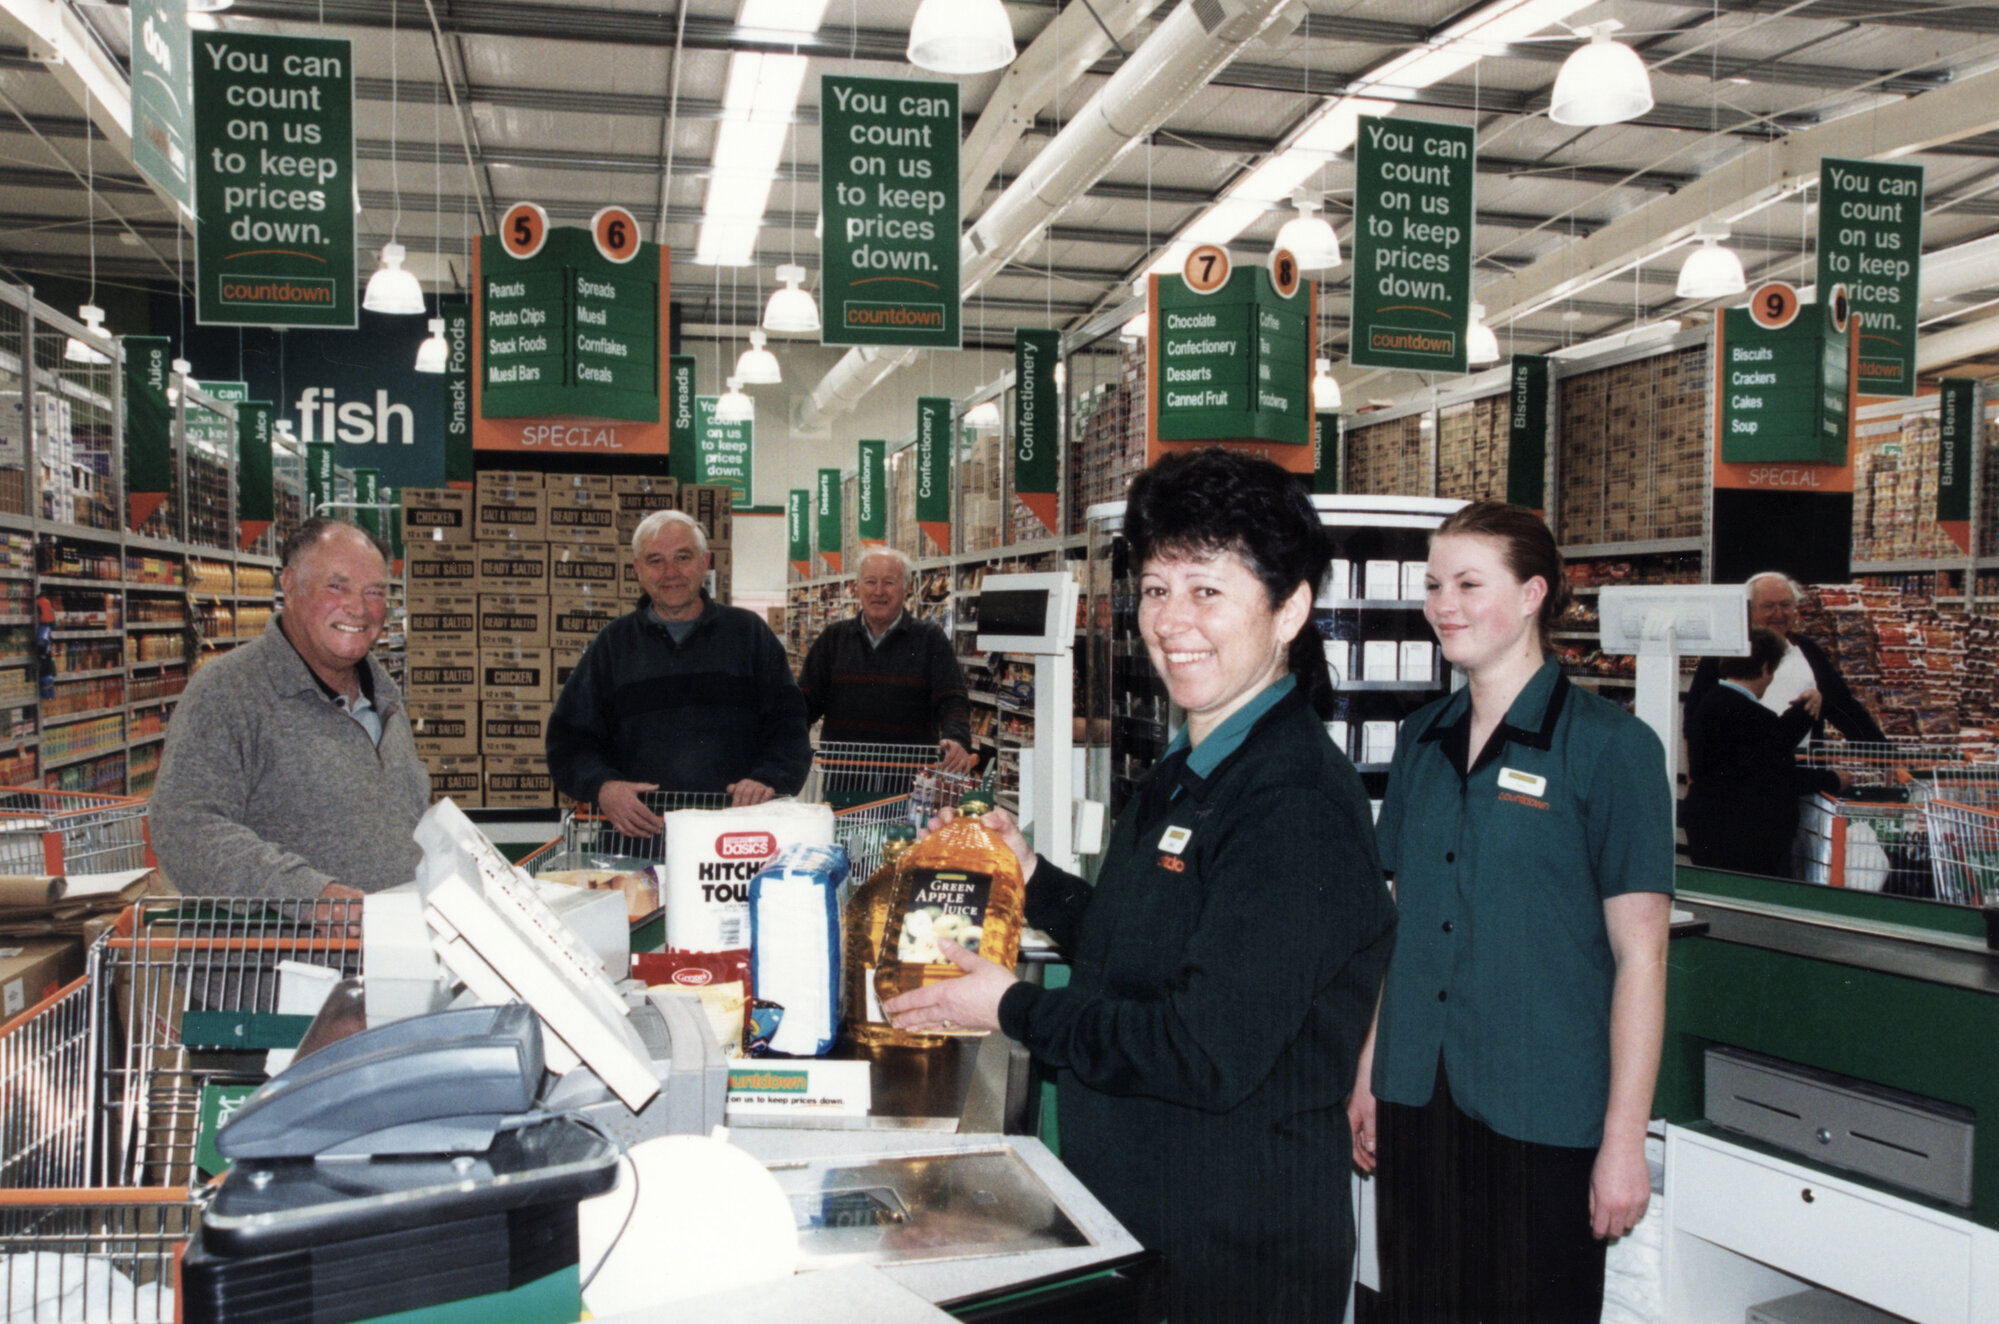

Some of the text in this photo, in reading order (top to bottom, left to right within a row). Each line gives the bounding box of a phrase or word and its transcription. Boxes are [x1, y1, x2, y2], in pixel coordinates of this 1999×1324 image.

[205, 42, 342, 78] You can
[226, 85, 321, 111] count
[833, 86, 950, 117] You can
[227, 119, 321, 144] on us
[850, 124, 932, 147] count
[1368, 125, 1466, 159] You can
[212, 148, 338, 184] to keep
[850, 155, 932, 178] on us
[1381, 162, 1450, 186] count
[1830, 168, 1917, 196] You can
[224, 182, 326, 213] prices
[837, 182, 945, 215] to keep
[1380, 191, 1449, 215] on us
[1841, 202, 1902, 223] count
[230, 215, 330, 245] down.
[514, 216, 532, 246] 5
[607, 220, 626, 249] 6
[847, 214, 935, 242] prices
[1368, 214, 1460, 249] to keep
[1840, 229, 1900, 249] on us
[852, 244, 939, 271] down.
[1376, 245, 1450, 272] prices
[1829, 251, 1910, 282] to keep
[1199, 255, 1216, 283] 7
[1280, 259, 1292, 286] 8
[223, 282, 331, 302] countdown
[489, 282, 525, 298] Peanuts
[577, 278, 616, 299] Spreads
[1379, 273, 1451, 301] down.
[577, 306, 606, 326] Muesli
[1766, 293, 1784, 319] 9
[489, 308, 545, 328] Potato Chips
[848, 308, 941, 325] countdown
[1167, 314, 1216, 329] Chocolate
[489, 336, 547, 355] Snack Foods
[577, 335, 627, 357] Cornflakes
[1167, 340, 1236, 356] Confectionery
[1372, 334, 1451, 352] countdown
[1733, 347, 1773, 361] Biscuits
[148, 349, 162, 390] Juice
[450, 318, 466, 434] Snack Foods
[489, 365, 540, 383] Muesli Bars
[577, 363, 613, 383] Cereals
[1167, 367, 1212, 382] Desserts
[1733, 371, 1776, 385] Crackers
[218, 390, 242, 399] can
[676, 367, 692, 429] Spreads
[1019, 342, 1038, 461] Confectionery
[1167, 391, 1228, 407] Canned Fruit
[1514, 366, 1528, 428] Biscuits
[1732, 395, 1763, 410] Cakes
[295, 387, 414, 444] fish
[256, 410, 267, 442] Juice
[707, 429, 742, 438] on us
[1732, 419, 1758, 435] Soup
[521, 426, 623, 448] SPECIAL
[701, 440, 747, 453] to keep
[1942, 390, 1956, 486] Baked Beans
[705, 453, 743, 465] prices
[919, 406, 935, 498] Confectionery
[707, 465, 744, 476] down.
[1748, 468, 1821, 487] SPECIAL
[861, 447, 873, 521] Confectionery
[820, 474, 829, 515] Desserts
[415, 511, 455, 525] CHICKEN
[552, 511, 611, 524] READY SALTED
[414, 561, 473, 577] READY SALTED
[484, 561, 542, 577] READY SALTED
[556, 563, 574, 577] SALT
[575, 564, 581, 577] &
[583, 565, 614, 579] VINEGAR
[414, 616, 472, 629] READY SALTED
[484, 617, 536, 629] READY SALTED
[414, 669, 473, 683] READY SALTED
[494, 671, 533, 684] CHICKEN
[438, 724, 465, 735] SALTED
[488, 724, 540, 735] READY SALTED
[447, 777, 477, 788] SALTED
[492, 778, 550, 789] READY SALTED
[723, 837, 768, 855] basics
[915, 888, 965, 904] APPLE
[930, 880, 975, 893] GREEN
[942, 903, 978, 916] JUICE
[757, 1095, 765, 1103] to
[768, 1095, 788, 1105] keep
[791, 1096, 817, 1105] prices
[819, 1097, 845, 1105] down.
